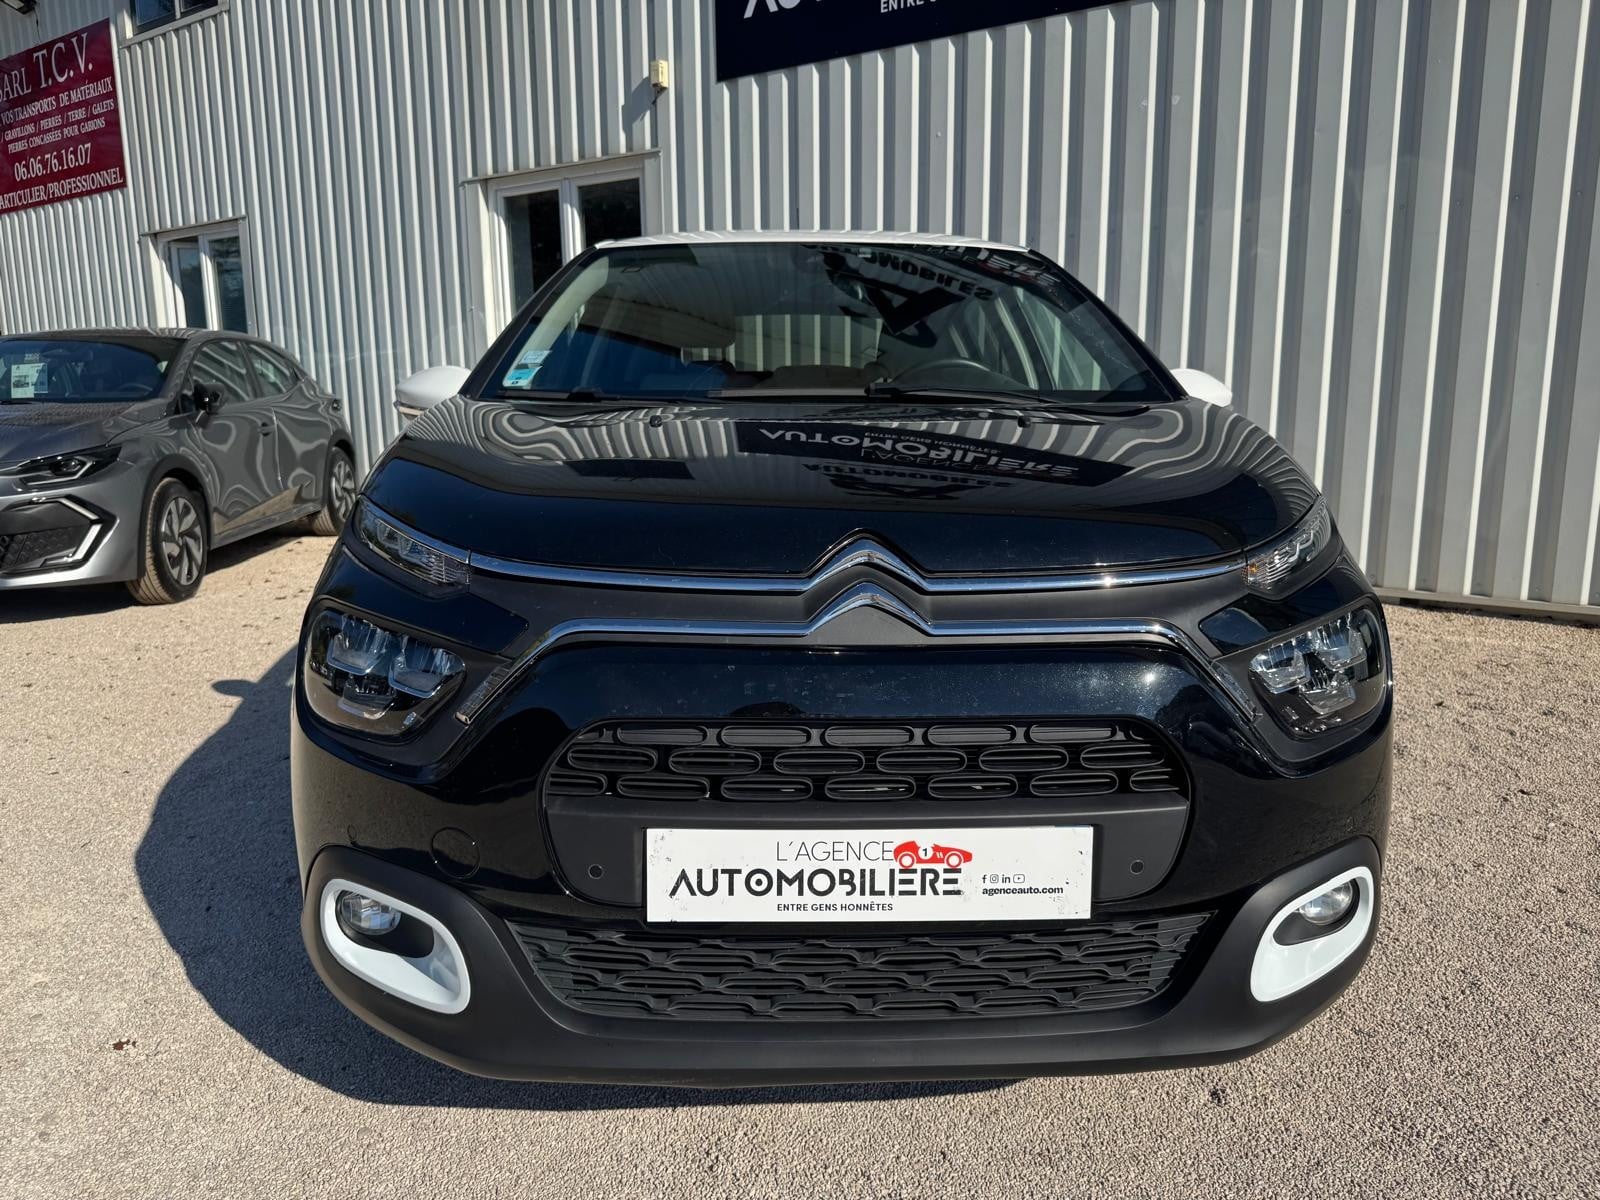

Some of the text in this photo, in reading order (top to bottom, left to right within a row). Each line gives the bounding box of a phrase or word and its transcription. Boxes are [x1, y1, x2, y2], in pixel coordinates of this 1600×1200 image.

[33, 32, 93, 88] T.C.V.
[1, 76, 113, 125] VOS TRANSPORTS DE MATÉRIAUX
[4, 122, 35, 141] GRAVILLONS
[40, 115, 62, 130] PIERRES
[68, 107, 87, 122] TERRE
[92, 98, 115, 115] GALETS
[8, 140, 28, 154] PIERRES
[63, 124, 80, 139] POUR
[80, 117, 106, 134] GABIONS
[14, 142, 92, 182] 06.06.76.16.07
[776, 841, 894, 861] L'AGENCE
[777, 901, 893, 912] ENTRE GENS HONNÊTES
[981, 886, 1064, 897] agenceauto.com
